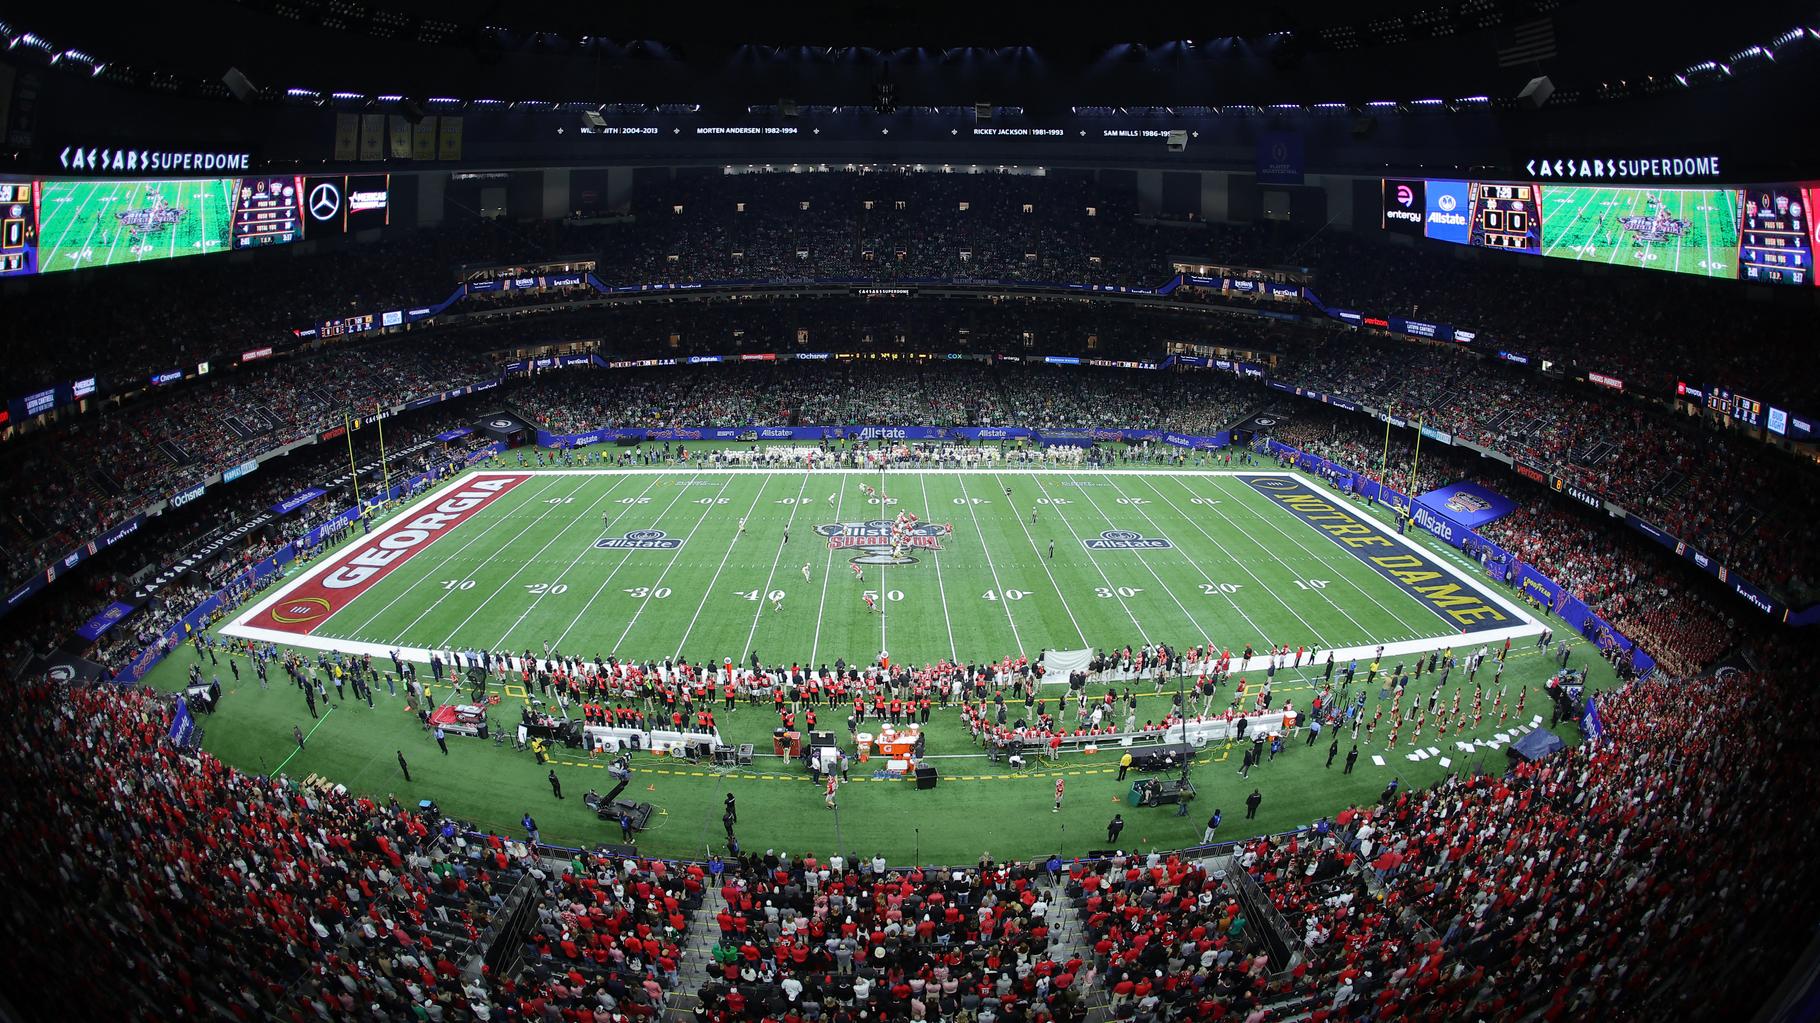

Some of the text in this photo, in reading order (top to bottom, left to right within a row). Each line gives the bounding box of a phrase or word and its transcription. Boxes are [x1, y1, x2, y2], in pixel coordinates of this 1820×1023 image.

[974, 128, 1064, 136] RICKEY JACKSON 1981-1993
[1103, 129, 1118, 137] SAM
[1119, 129, 1139, 137] MILLS
[60, 146, 250, 171] CAESARS SUPERDOME
[1526, 156, 1720, 178] CAESARS SUPERDOME
[1387, 210, 1421, 223] entergy
[1427, 212, 1468, 226] Allstate
[1490, 212, 1521, 228] 0 0
[1364, 317, 1389, 327] verizon
[800, 352, 828, 360] Ochsner
[1507, 353, 1526, 363] Chevron
[160, 371, 181, 382] Chevron
[761, 429, 791, 437] Allstate
[860, 427, 907, 439] Allstate
[977, 429, 1007, 438] Allstate
[1166, 435, 1190, 446] Allstate
[1516, 464, 1543, 483] verizon
[174, 485, 205, 507] Ochsner
[1568, 486, 1600, 509] CAESARS
[1413, 507, 1453, 541] Allstate
[201, 512, 273, 556] SUPERDOME
[322, 478, 516, 589] GEORGIA
[601, 539, 673, 548] Allstate
[1091, 538, 1166, 548] Allstate
[1273, 493, 1506, 625] NOTRE DAME
[445, 580, 476, 591] 10
[531, 583, 568, 595] 20
[1198, 583, 1238, 594] 20
[1294, 578, 1328, 590] 10
[631, 587, 672, 599] 30
[743, 589, 786, 601] 40
[982, 588, 1025, 600] 40
[1095, 586, 1137, 598] 30
